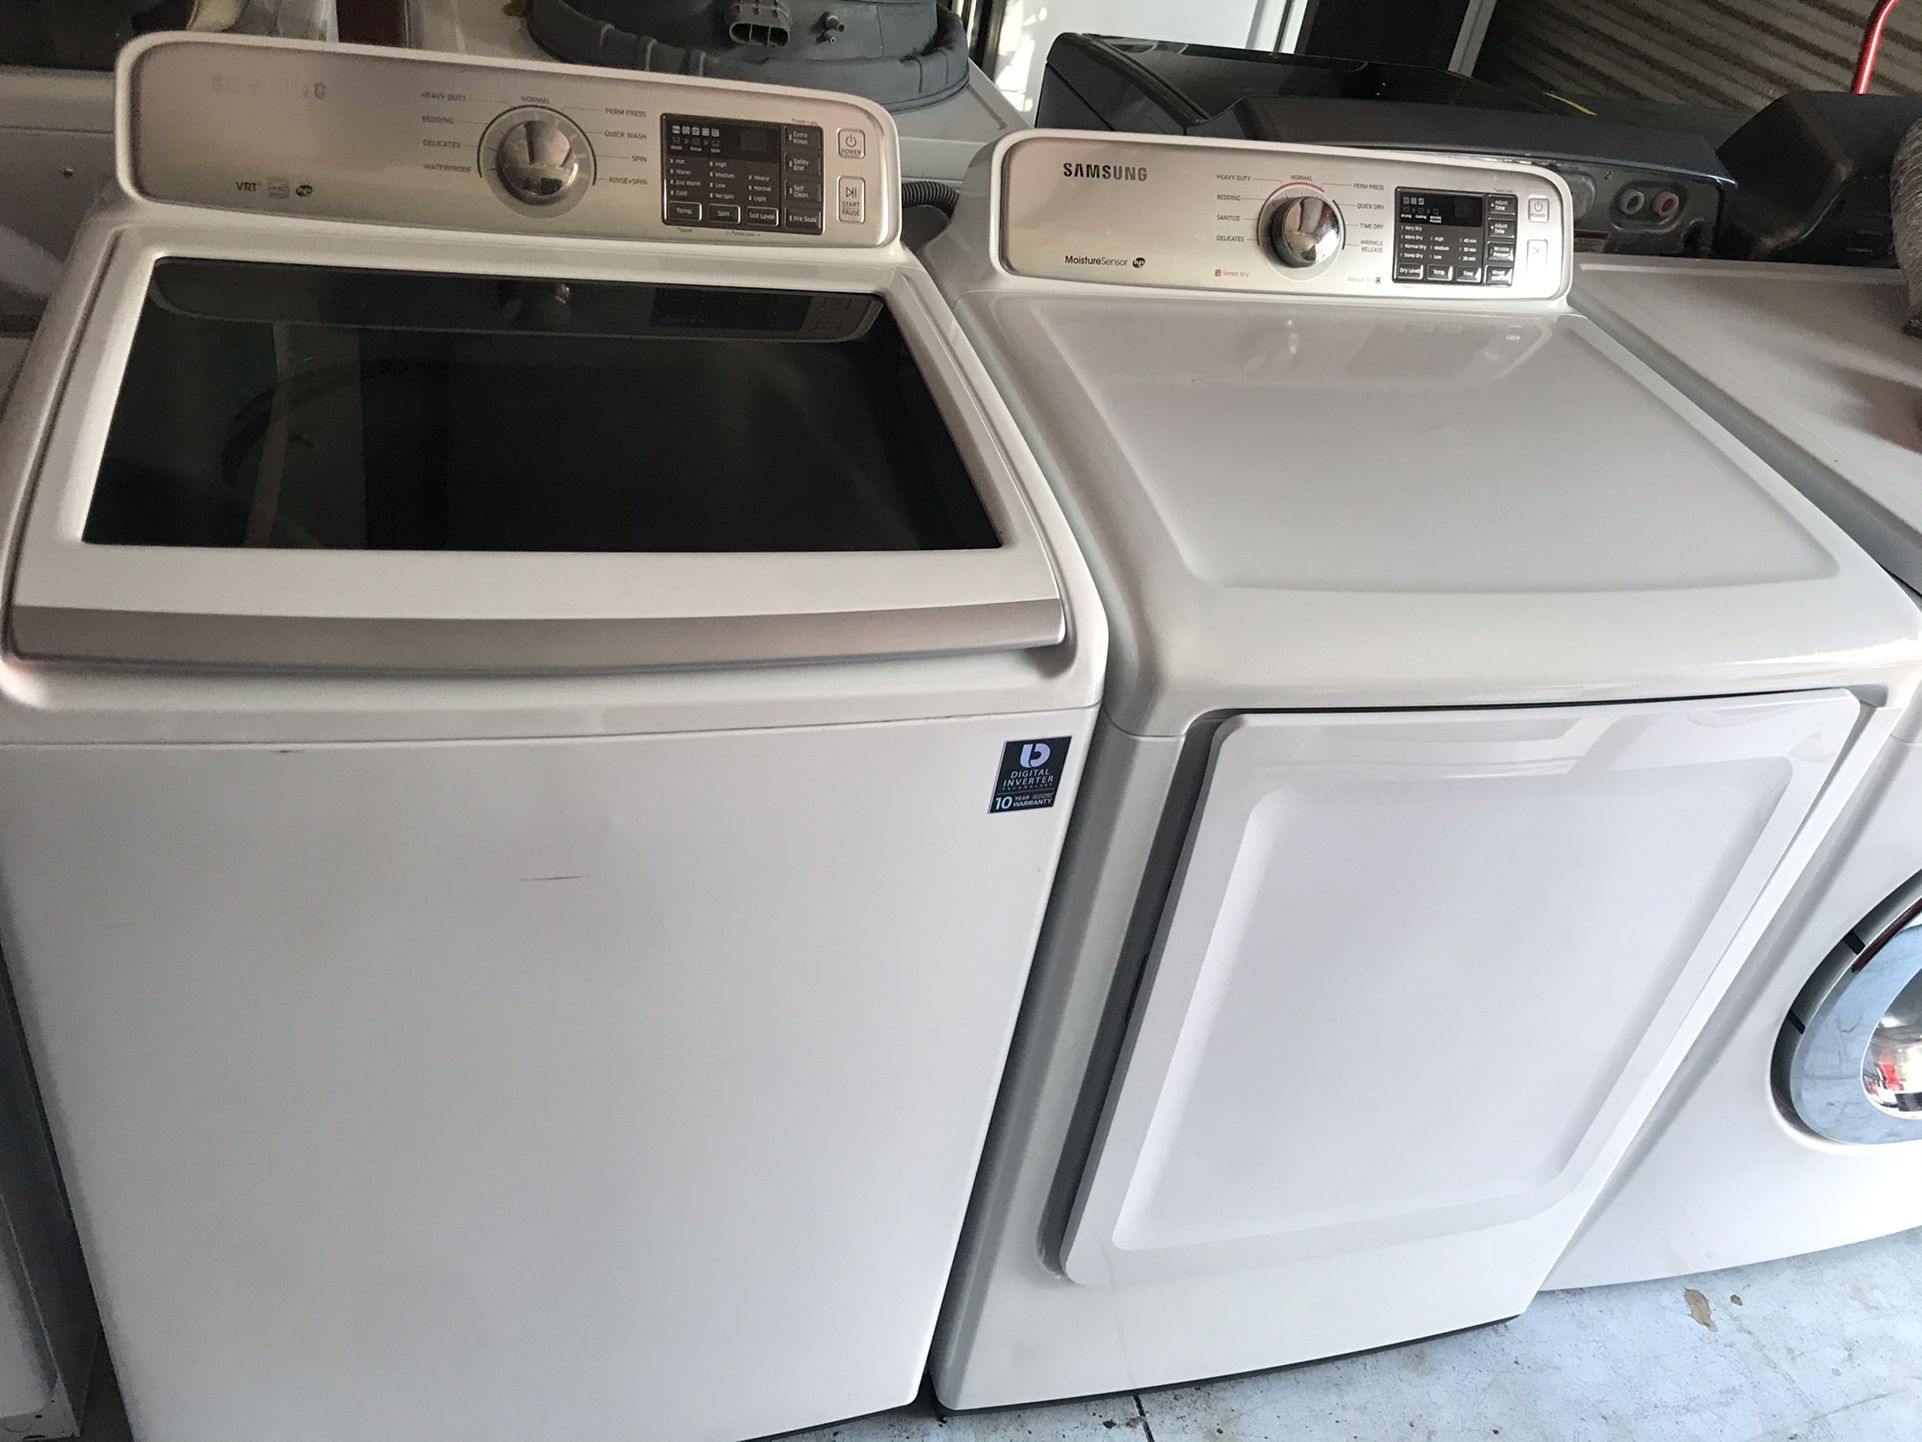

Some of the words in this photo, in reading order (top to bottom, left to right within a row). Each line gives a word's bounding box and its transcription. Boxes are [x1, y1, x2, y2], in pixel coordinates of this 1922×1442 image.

[421, 92, 445, 100] HEAVY
[447, 94, 466, 102] DUTY
[520, 96, 551, 105] NORMAL
[604, 107, 624, 116] PERM
[626, 109, 647, 118] PRESS
[422, 115, 454, 125] BEDDING
[603, 130, 625, 139] QUICK
[627, 131, 647, 140] WASH
[422, 139, 461, 149] DELICATES
[631, 155, 647, 163] SPIN
[793, 158, 809, 166] Delay
[424, 163, 472, 173] WATERPROOF
[715, 161, 727, 169] High
[1063, 162, 1148, 182] SAMSUNG
[608, 177, 648, 186] RINSE+SPIN
[1216, 174, 1235, 182] HEAVY
[1290, 174, 1313, 182] NORMAL
[1353, 182, 1368, 190] PERM
[1216, 194, 1241, 202] BEDDING
[1356, 202, 1371, 211] QUICK
[1372, 203, 1384, 211] DRY
[760, 212, 776, 220] Level
[793, 214, 803, 222] Pre
[1216, 214, 1241, 222] SANITIZE
[1360, 222, 1373, 230] TIME
[1216, 235, 1245, 243] DELICATES
[1360, 239, 1384, 247] WRINKLE
[1010, 768, 1050, 779] DIGITAL
[1003, 775, 1054, 787] INVERTER
[995, 796, 1013, 810] 10
[1012, 798, 1053, 808] WARRANTY
